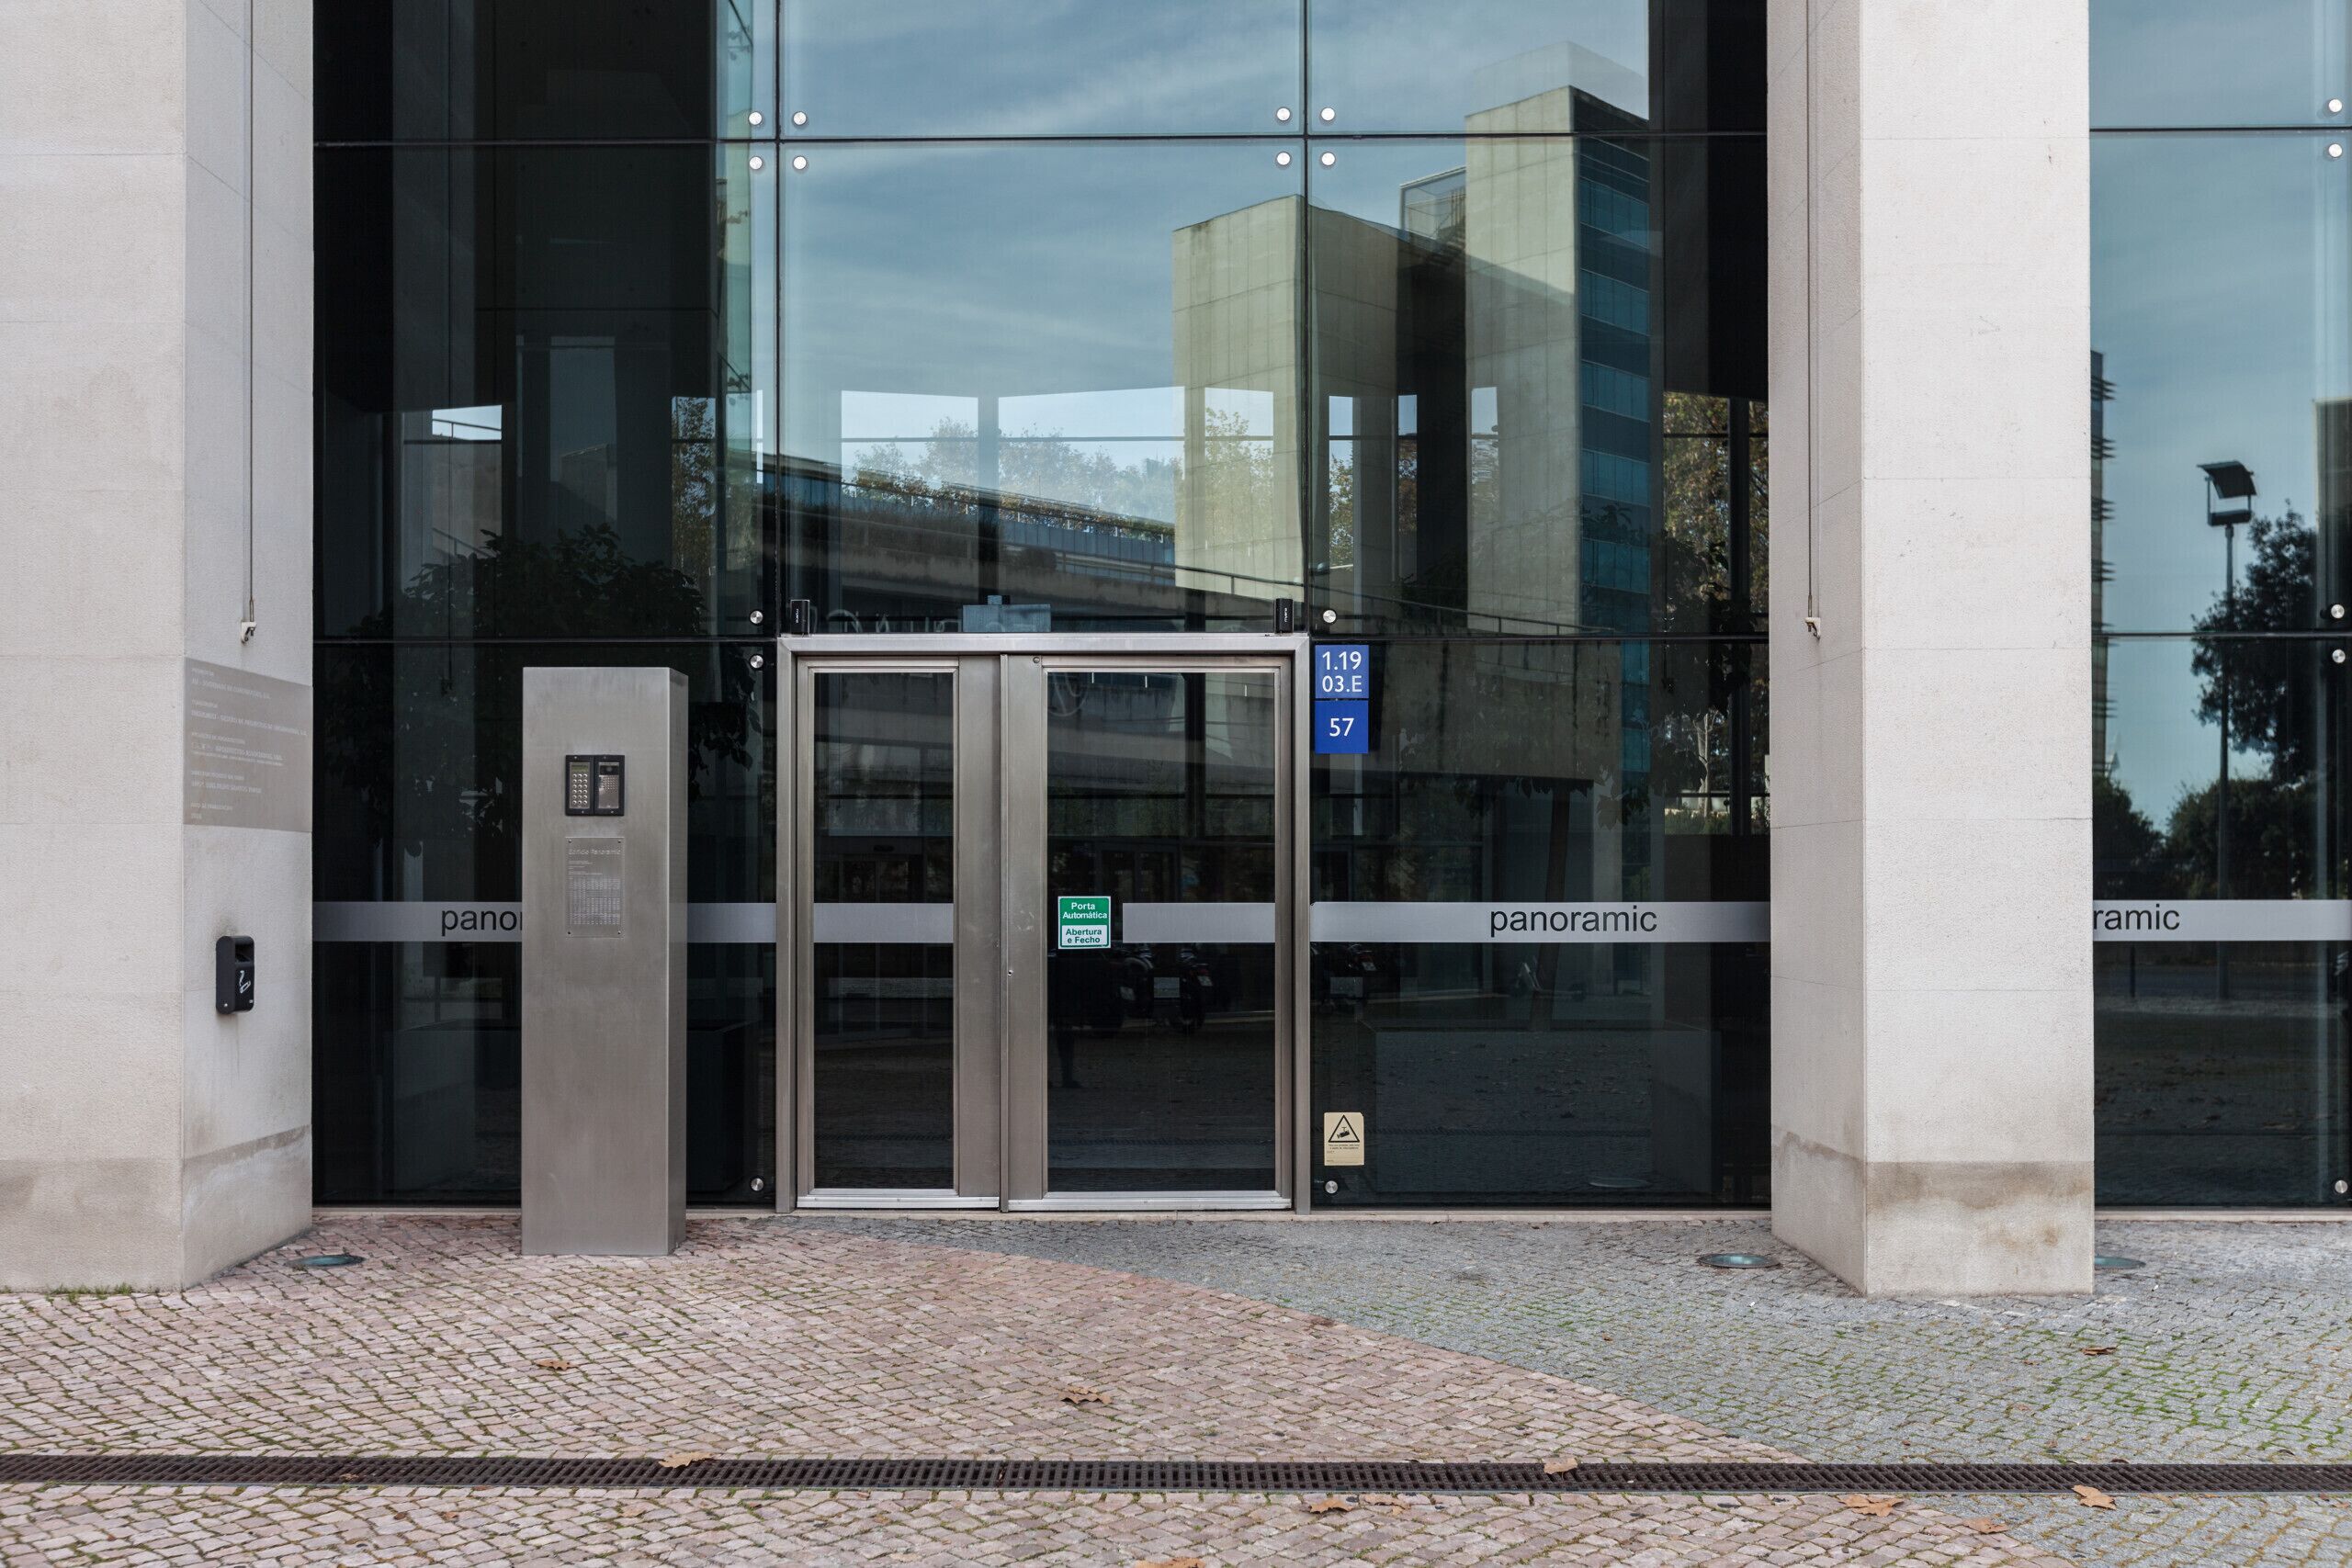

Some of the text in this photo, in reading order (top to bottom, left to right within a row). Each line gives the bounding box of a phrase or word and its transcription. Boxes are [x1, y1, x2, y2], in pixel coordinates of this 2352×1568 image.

[1322, 650, 1362, 671] 1.19
[1321, 675, 1363, 693] 03.E
[1329, 717, 1355, 737] 57
[1062, 911, 1108, 919] Automática
[1070, 902, 1096, 910] Porta
[441, 909, 523, 937] pano
[1490, 905, 1657, 938] panoramic
[1066, 928, 1102, 936] Abertura
